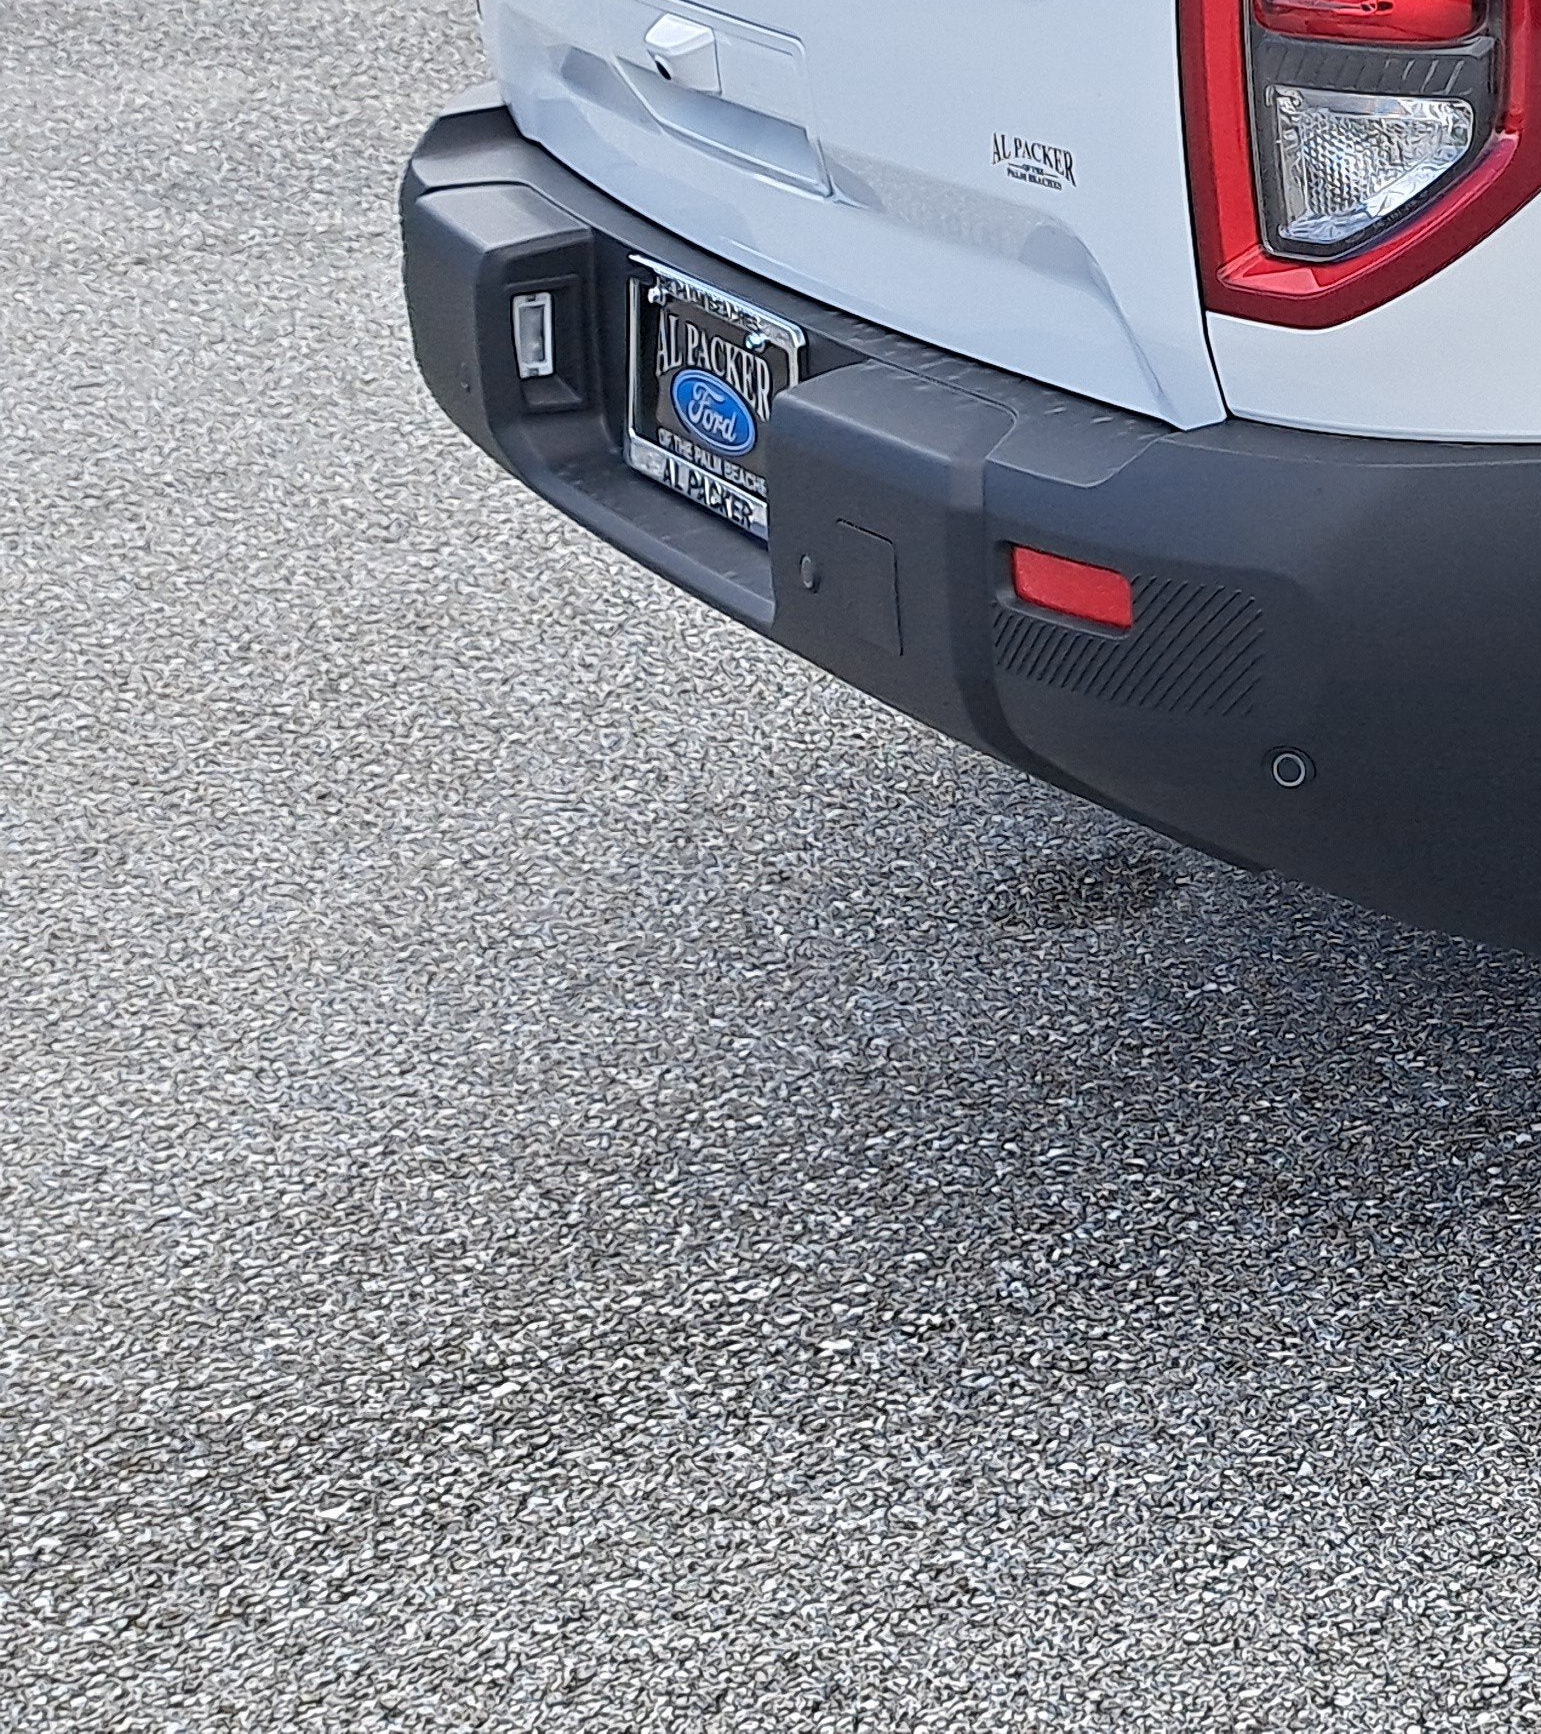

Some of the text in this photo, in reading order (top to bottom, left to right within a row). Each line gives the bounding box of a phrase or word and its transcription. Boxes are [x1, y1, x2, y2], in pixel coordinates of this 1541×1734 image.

[992, 131, 1077, 187] AL PACKER
[656, 308, 771, 423] AL PACKER
[688, 382, 738, 444] Ford
[663, 457, 753, 529] AL PACKER
[673, 434, 694, 462] THE
[723, 459, 768, 498] BEACHE
